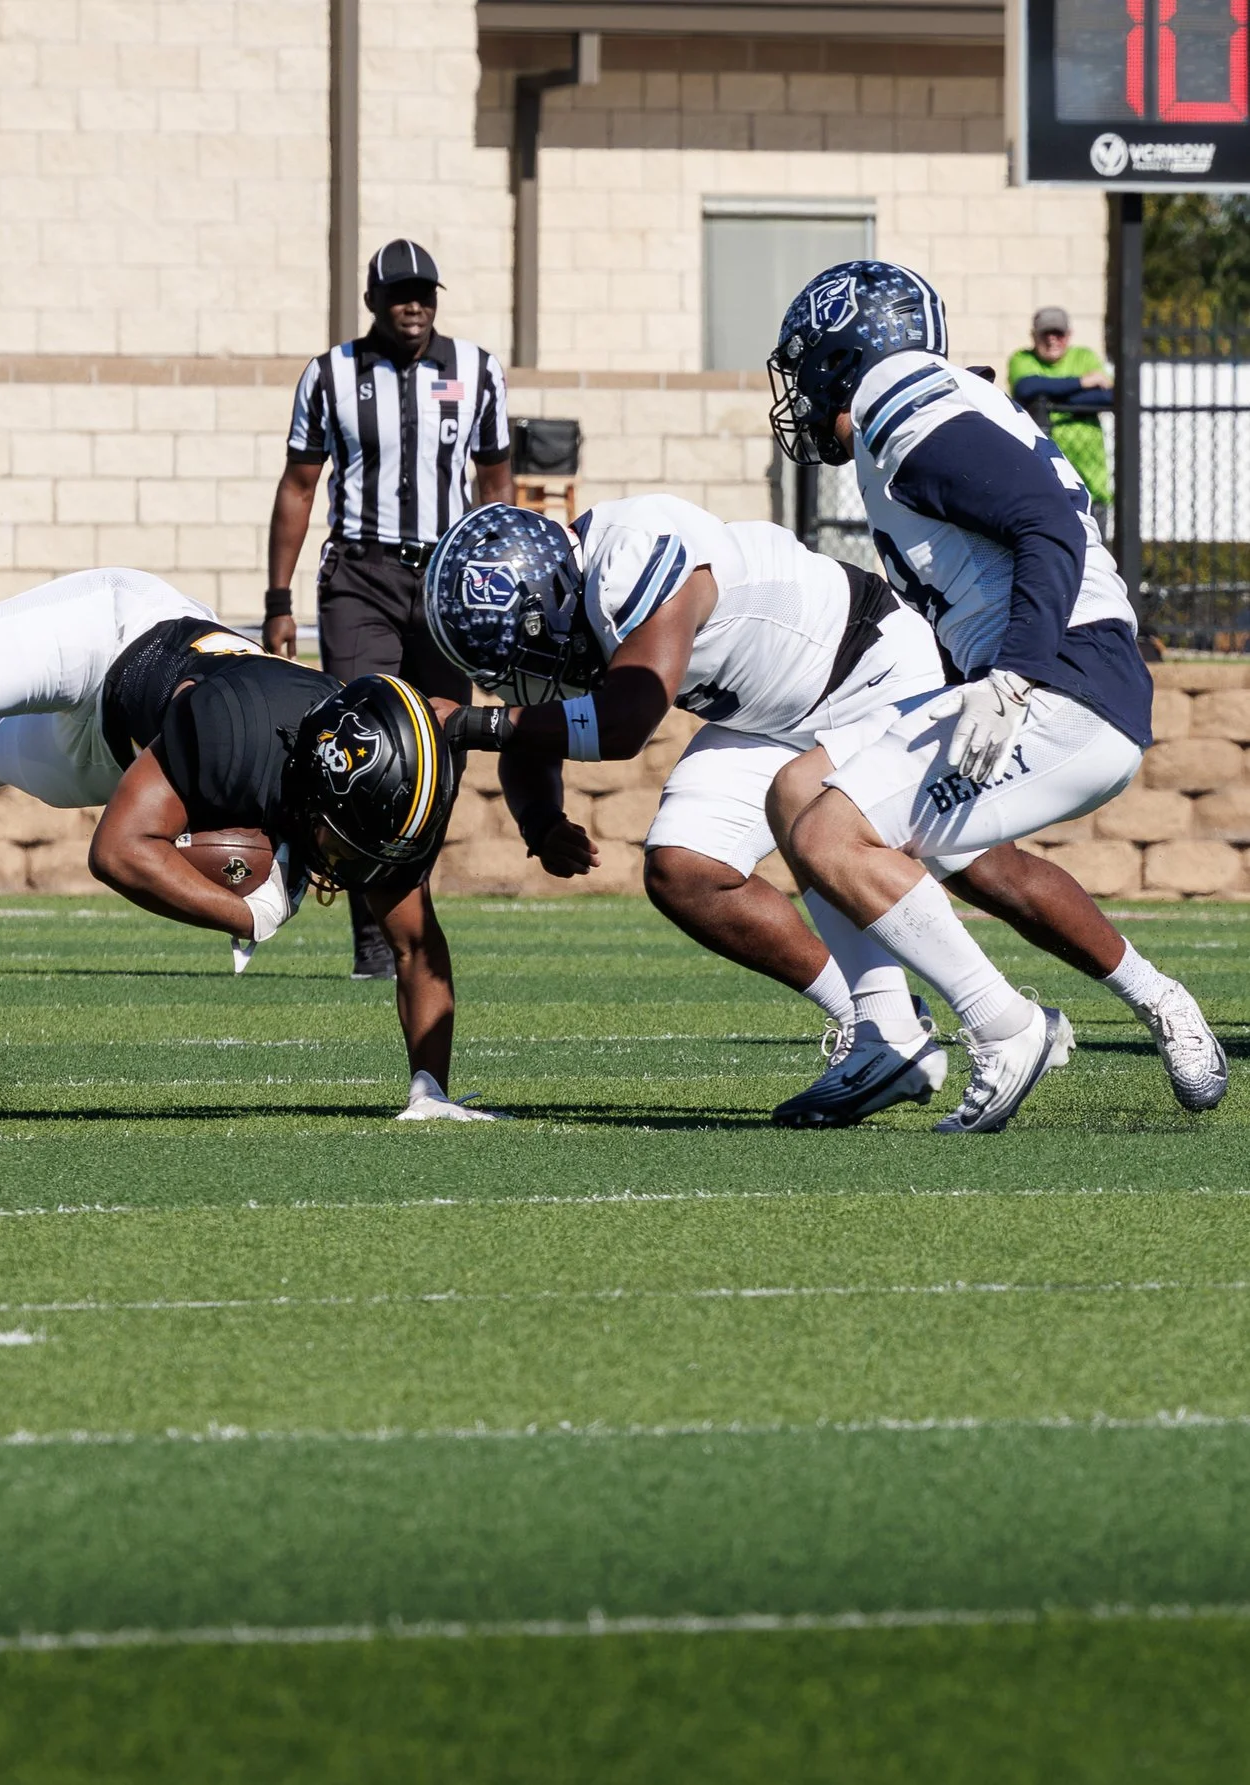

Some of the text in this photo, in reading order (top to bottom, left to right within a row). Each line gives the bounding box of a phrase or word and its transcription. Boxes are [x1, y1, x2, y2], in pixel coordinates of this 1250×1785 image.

[1126, 0, 1248, 122] 10
[360, 383, 373, 400] S
[440, 418, 458, 444] C
